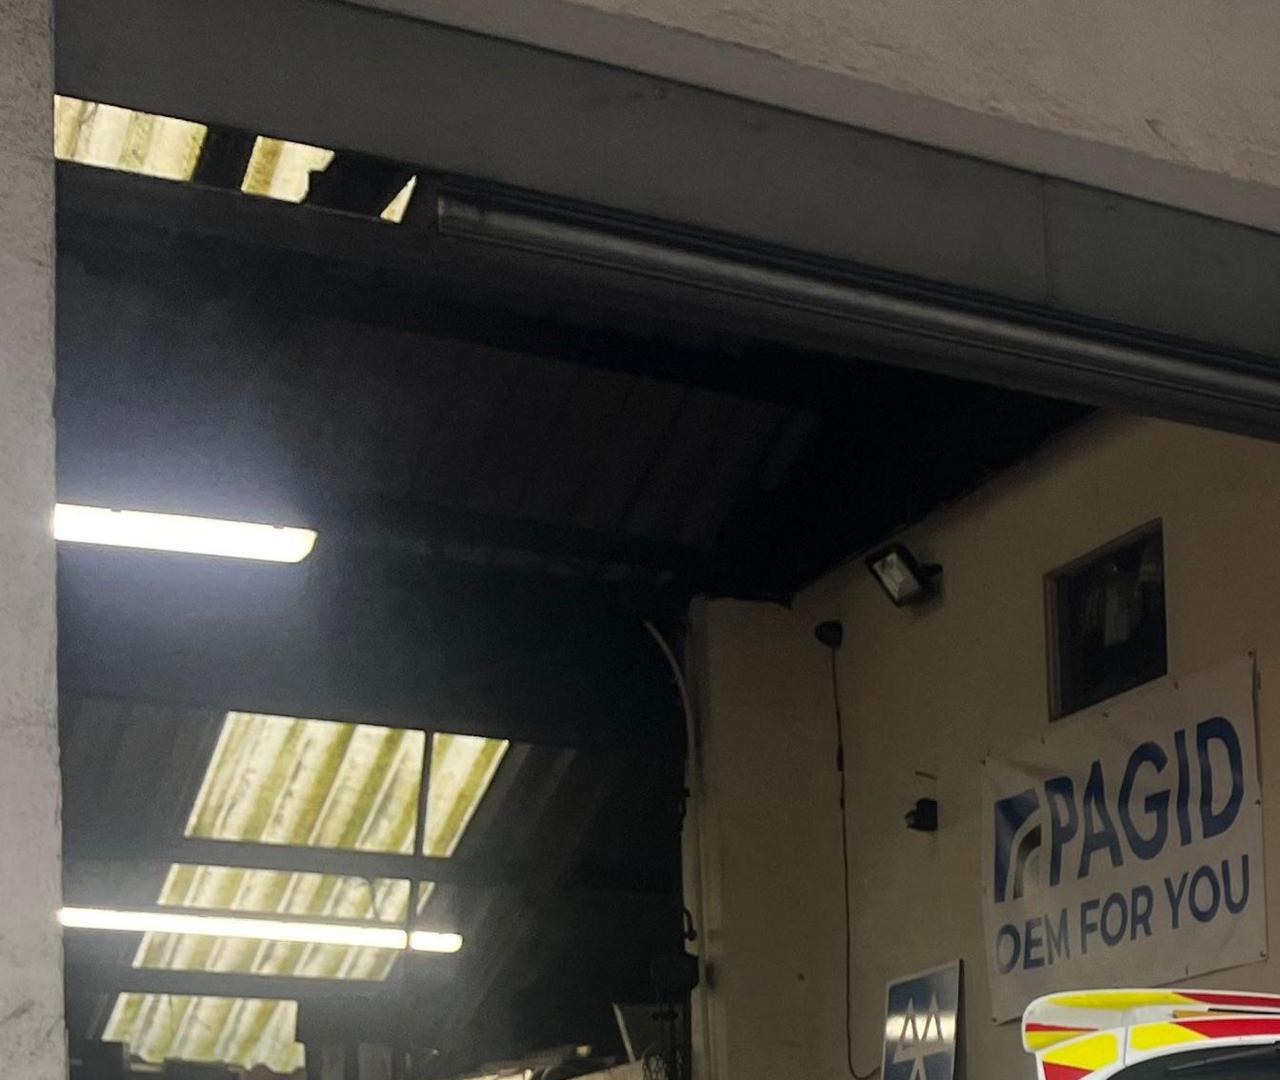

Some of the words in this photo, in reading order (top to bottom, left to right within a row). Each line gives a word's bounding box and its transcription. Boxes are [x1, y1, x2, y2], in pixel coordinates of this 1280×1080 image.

[1044, 716, 1245, 887] PAGID
[996, 908, 1071, 975] OEM
[1080, 885, 1154, 954] FOR
[1164, 854, 1250, 930] YOU
